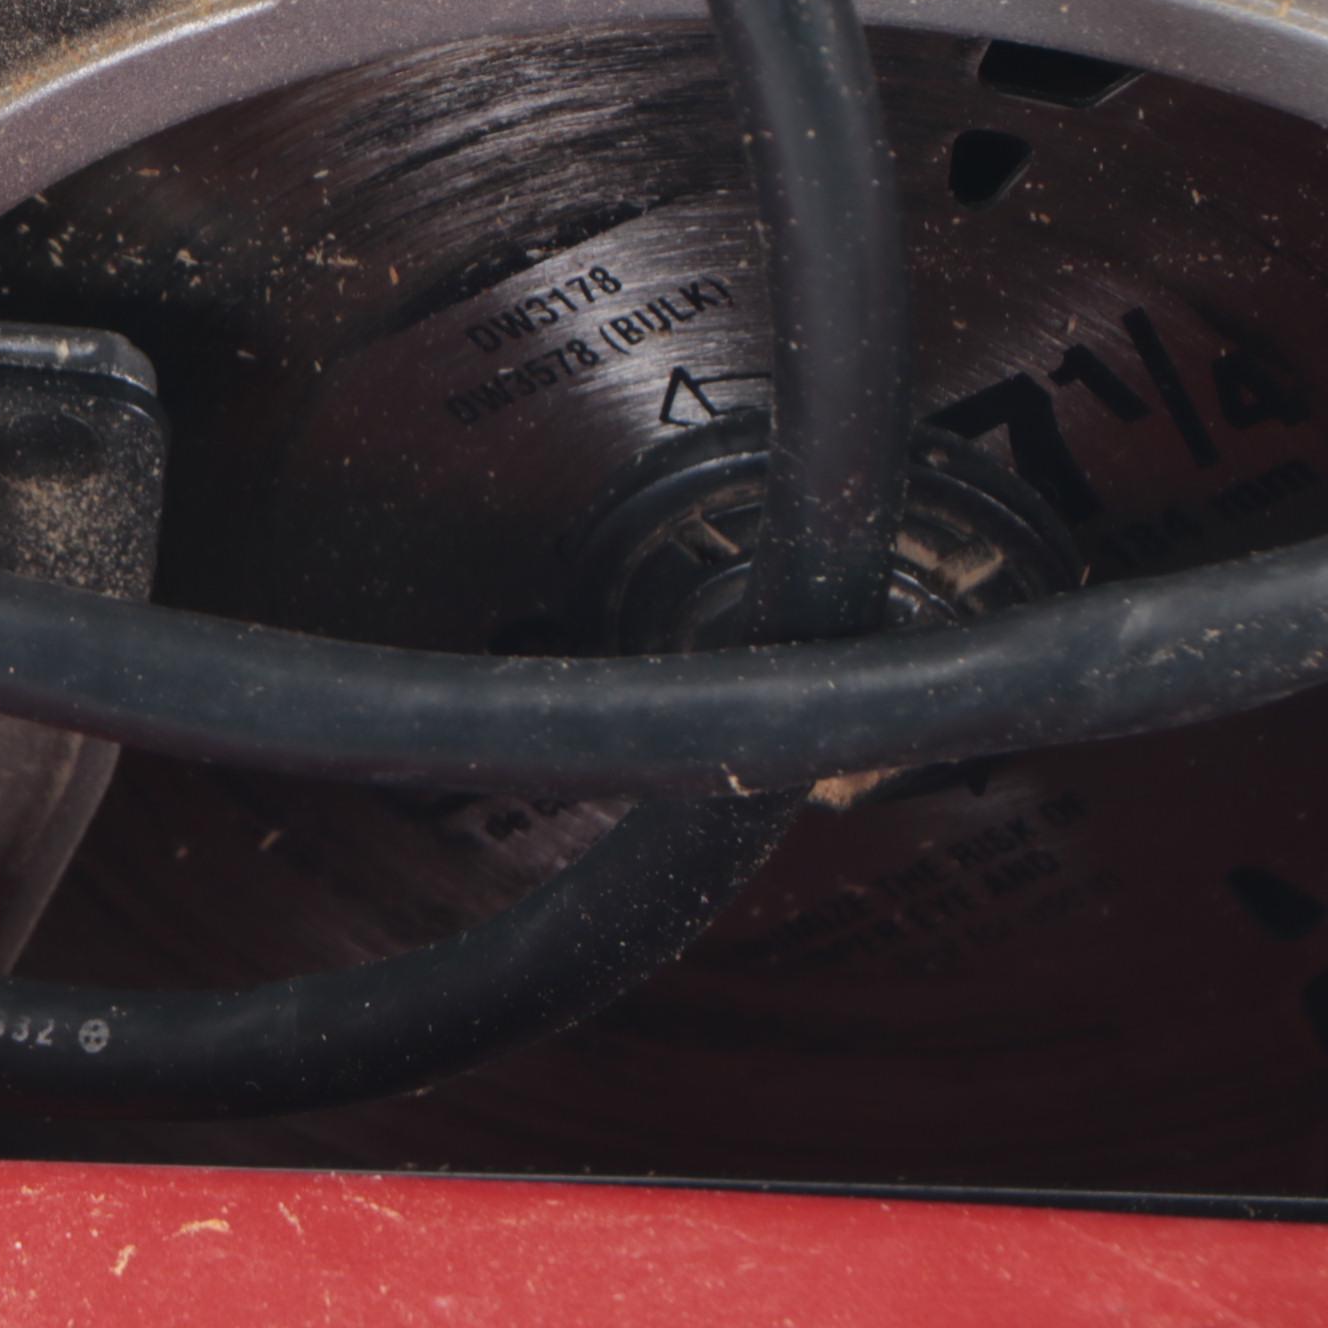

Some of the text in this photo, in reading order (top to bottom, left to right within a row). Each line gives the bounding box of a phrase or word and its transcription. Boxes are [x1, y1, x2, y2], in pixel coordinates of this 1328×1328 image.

[445, 277, 735, 425] DW3578 (BULK)
[465, 265, 623, 354] DW3178
[947, 816, 1034, 869] RISK
